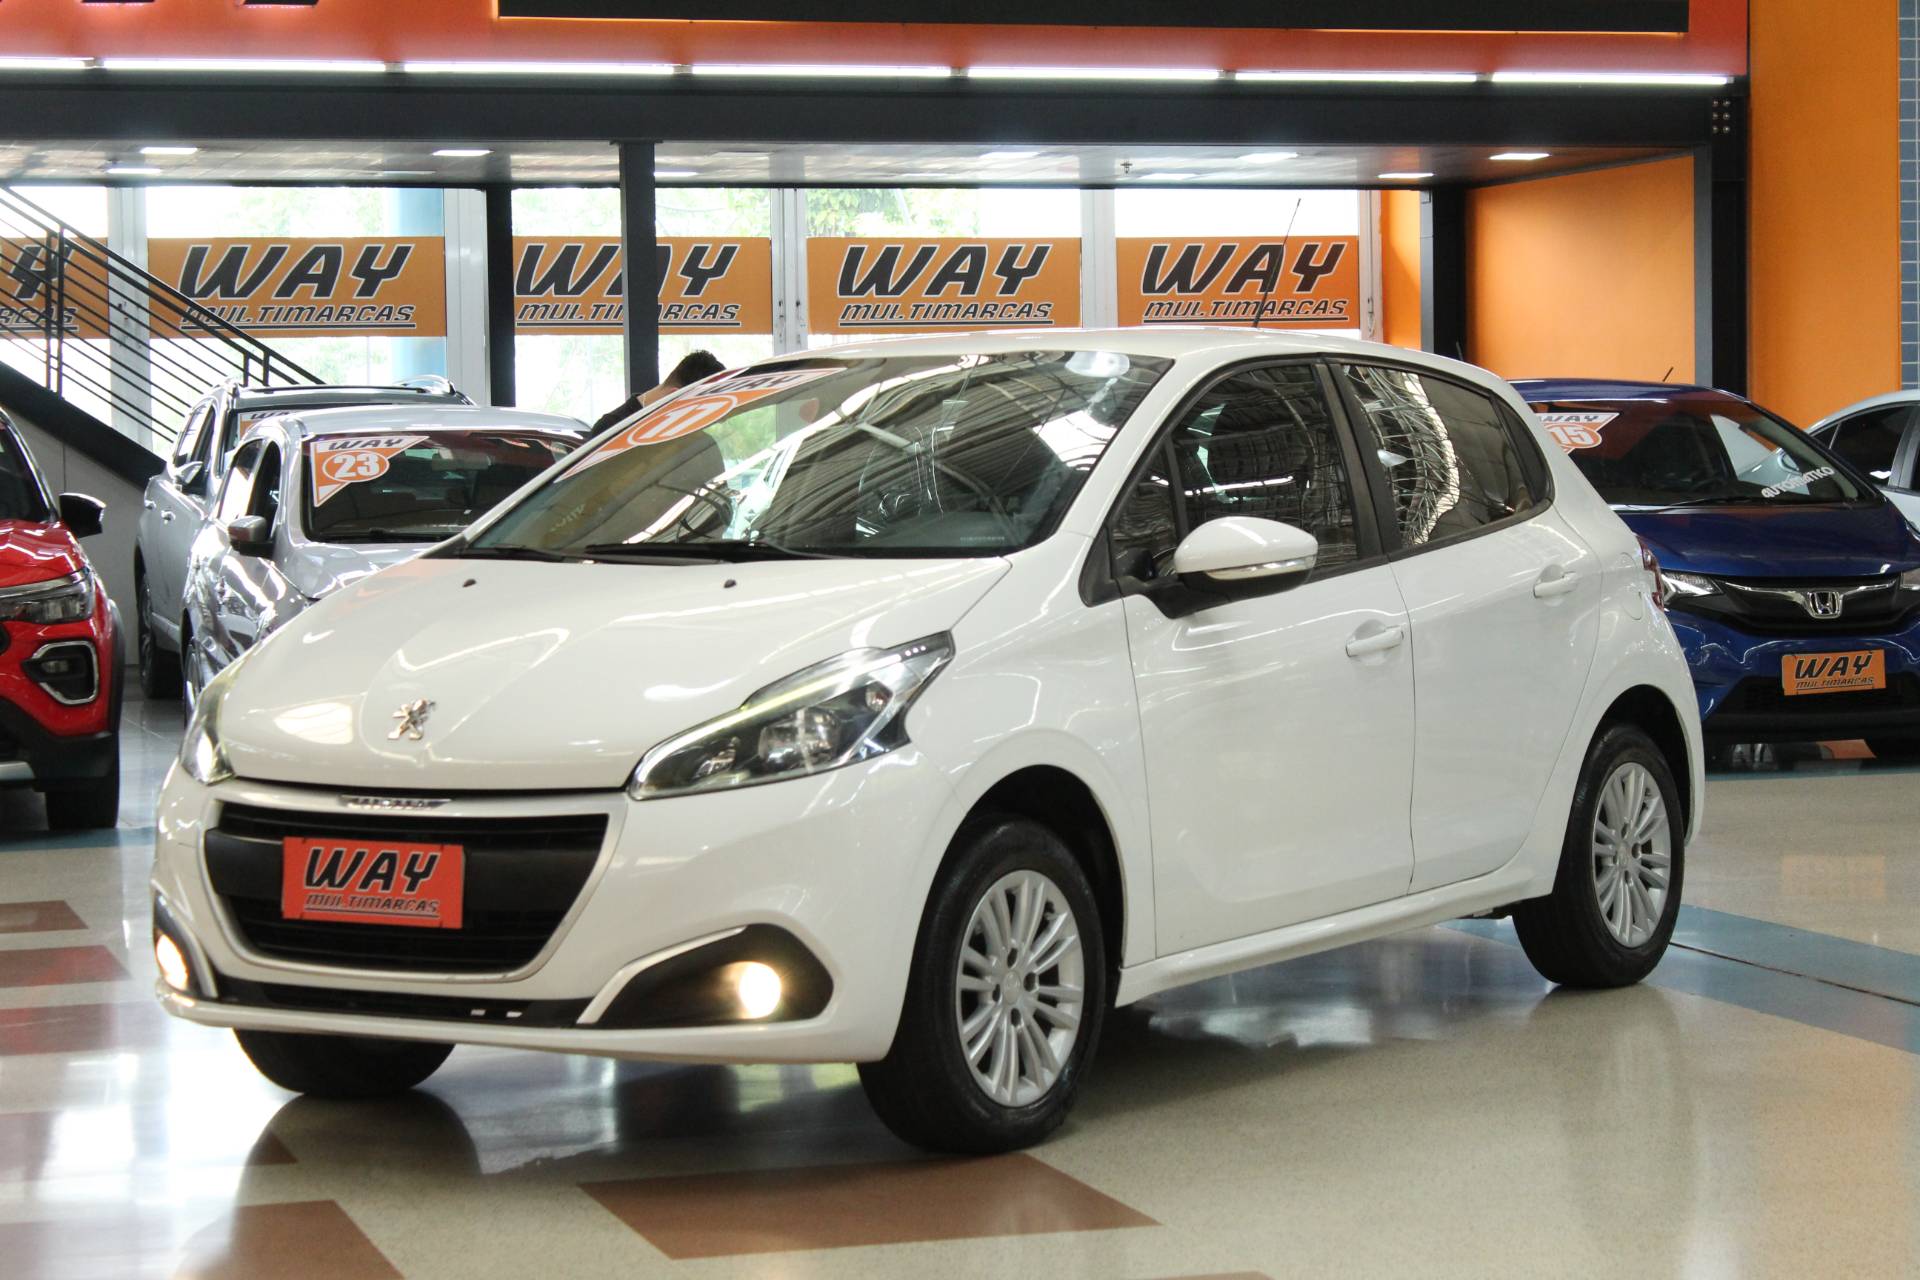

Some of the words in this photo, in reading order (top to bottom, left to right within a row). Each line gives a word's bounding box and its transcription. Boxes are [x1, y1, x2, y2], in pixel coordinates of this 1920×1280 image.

[178, 244, 415, 300] WAY
[837, 244, 1053, 297] WAY
[1141, 242, 1348, 295] WAY
[517, 303, 741, 320] MULTIRCAS
[839, 302, 1053, 320] MULTIMARCAS
[1143, 299, 1349, 317] MULTIMARCAS
[637, 399, 731, 440] 17
[328, 438, 403, 451] WAY
[1549, 426, 1595, 445] 15
[333, 452, 381, 479] 23
[1795, 655, 1873, 679] WAY
[304, 846, 441, 894] WAY
[306, 893, 441, 914] MULTIMARCAS
